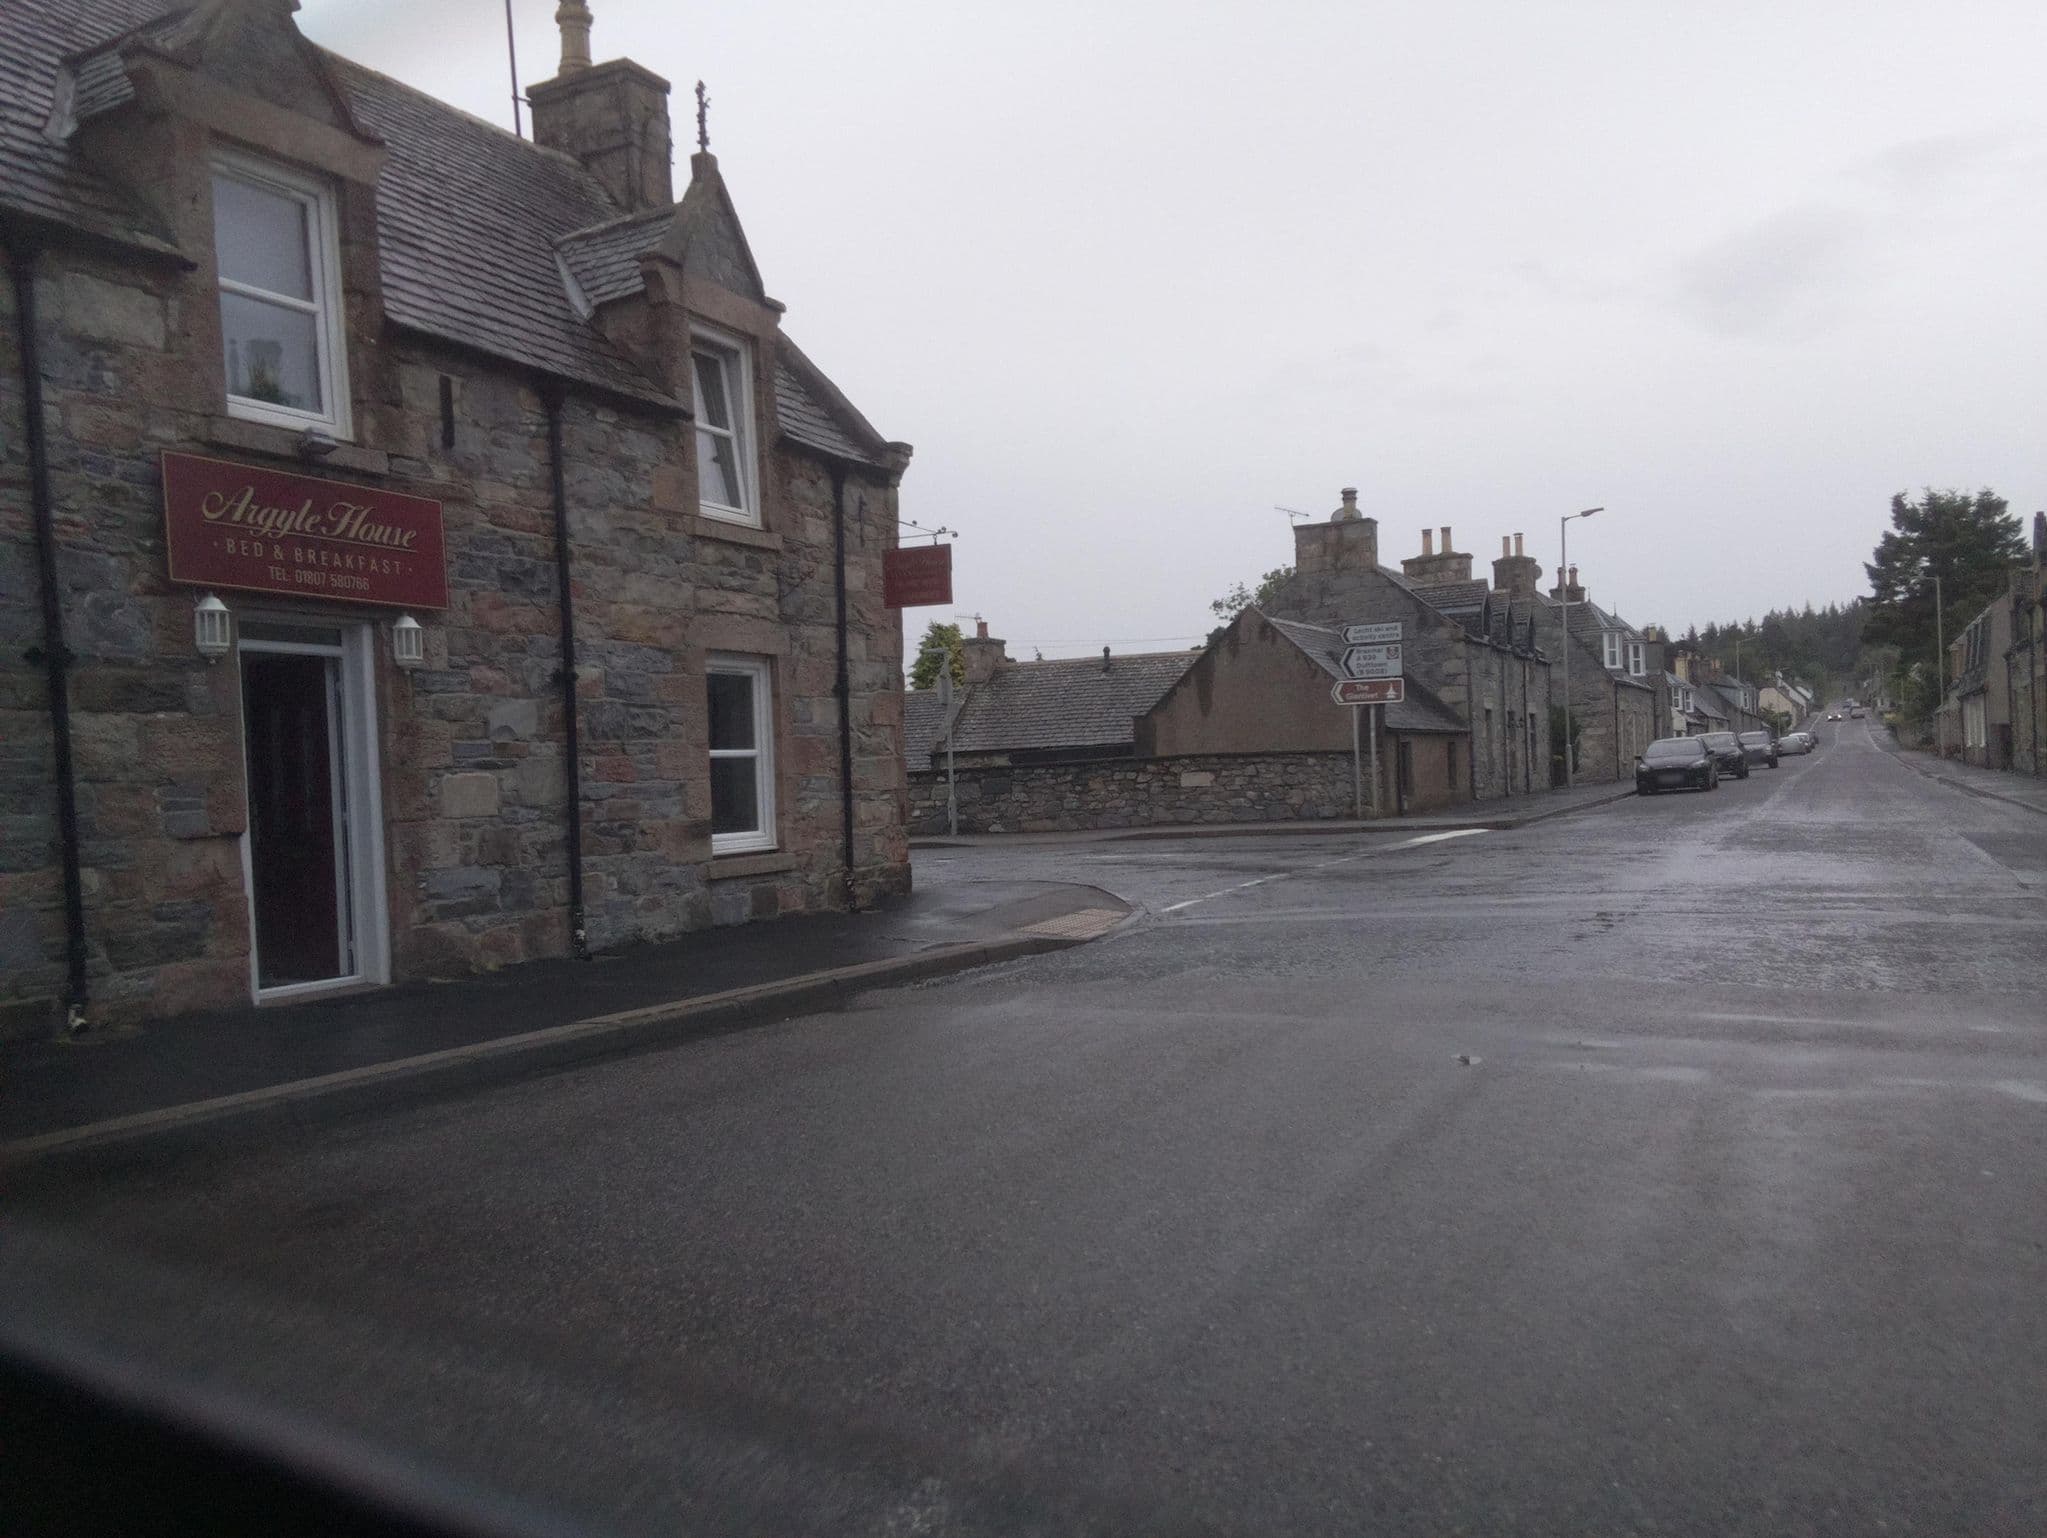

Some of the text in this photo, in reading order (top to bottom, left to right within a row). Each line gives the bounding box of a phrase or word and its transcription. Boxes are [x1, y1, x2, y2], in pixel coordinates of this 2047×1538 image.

[202, 485, 418, 548] Argyle House
[226, 537, 403, 576] BED & BREAKFAST
